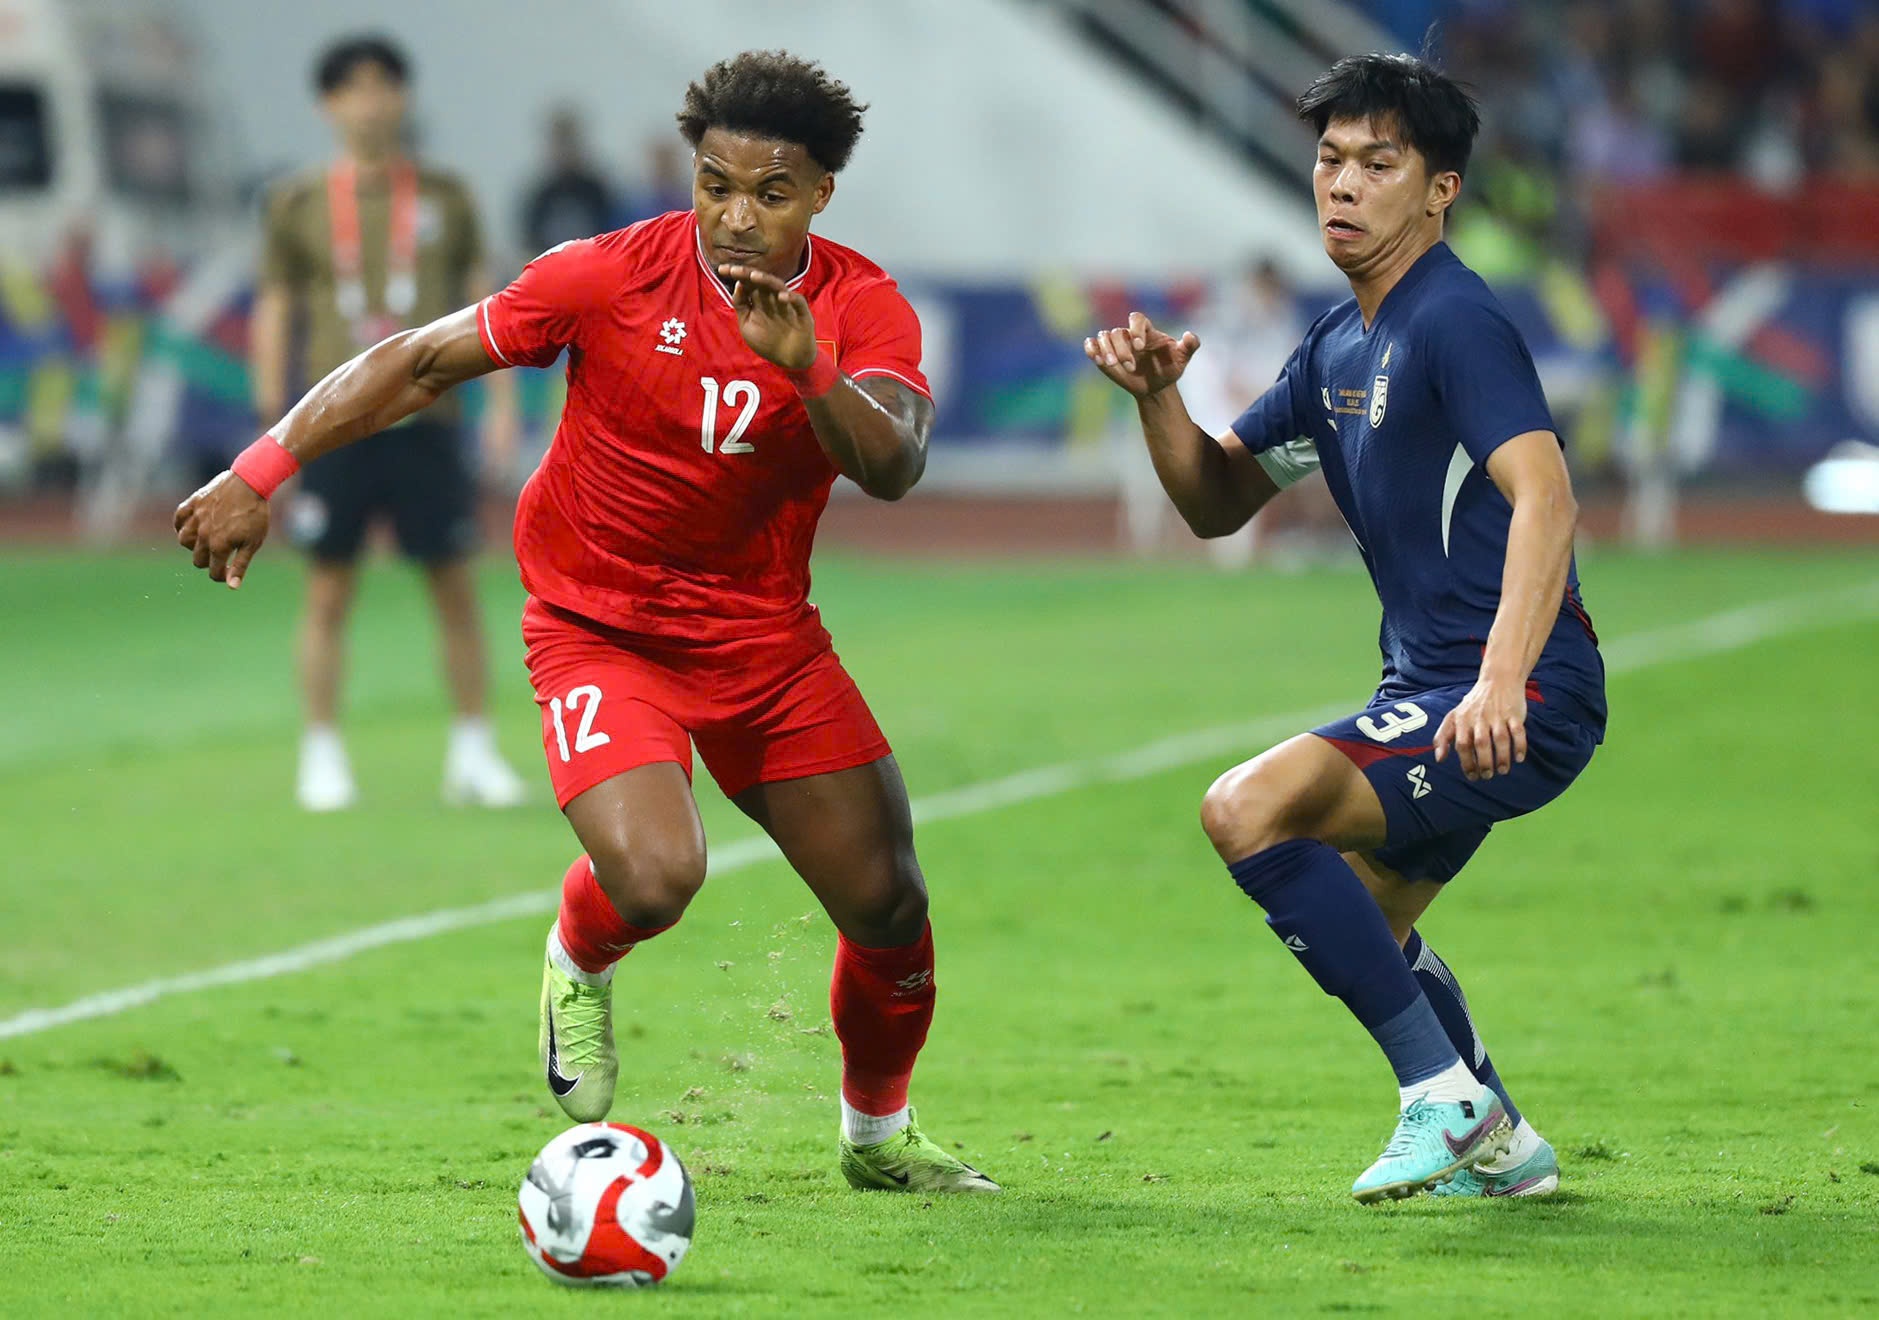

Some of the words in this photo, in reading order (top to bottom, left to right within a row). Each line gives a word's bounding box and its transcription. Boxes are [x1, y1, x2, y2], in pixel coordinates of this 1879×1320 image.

[700, 376, 761, 454] 12
[549, 684, 611, 763] 12
[1355, 702, 1428, 743] 3
